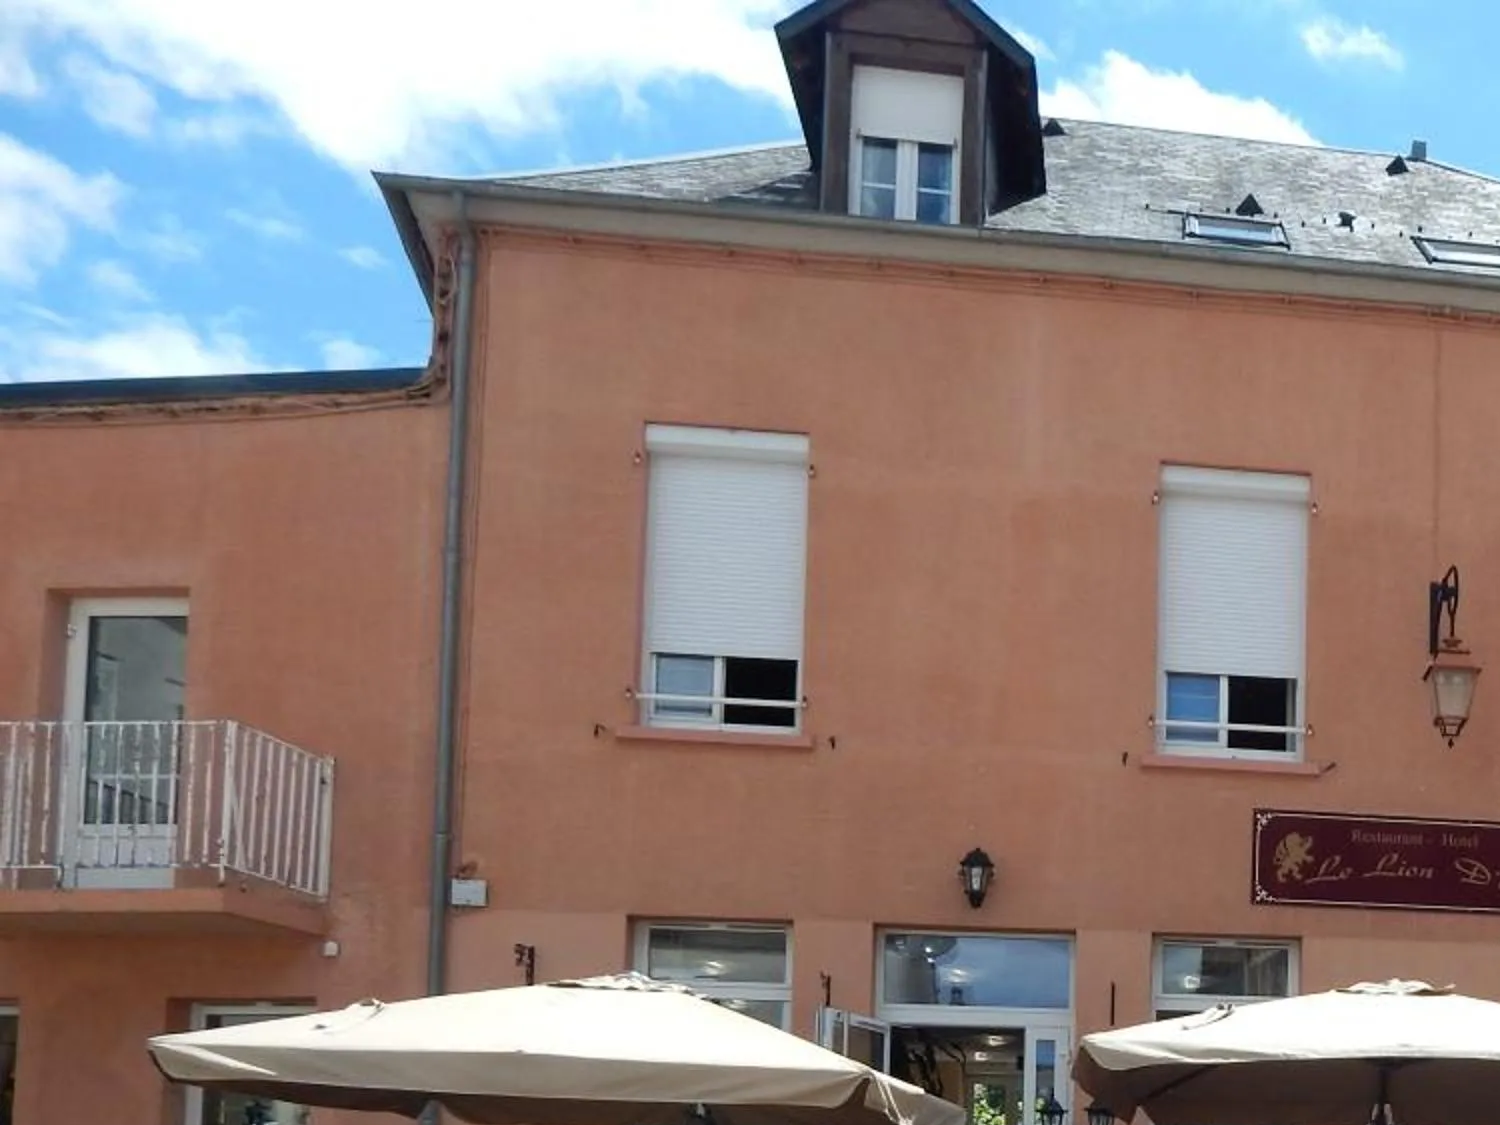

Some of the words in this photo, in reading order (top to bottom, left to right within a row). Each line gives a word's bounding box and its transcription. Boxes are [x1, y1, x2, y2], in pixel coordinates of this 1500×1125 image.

[1351, 829, 1423, 846] Restaurant
[1304, 855, 1353, 883] Le
[1362, 853, 1434, 879] Lion
